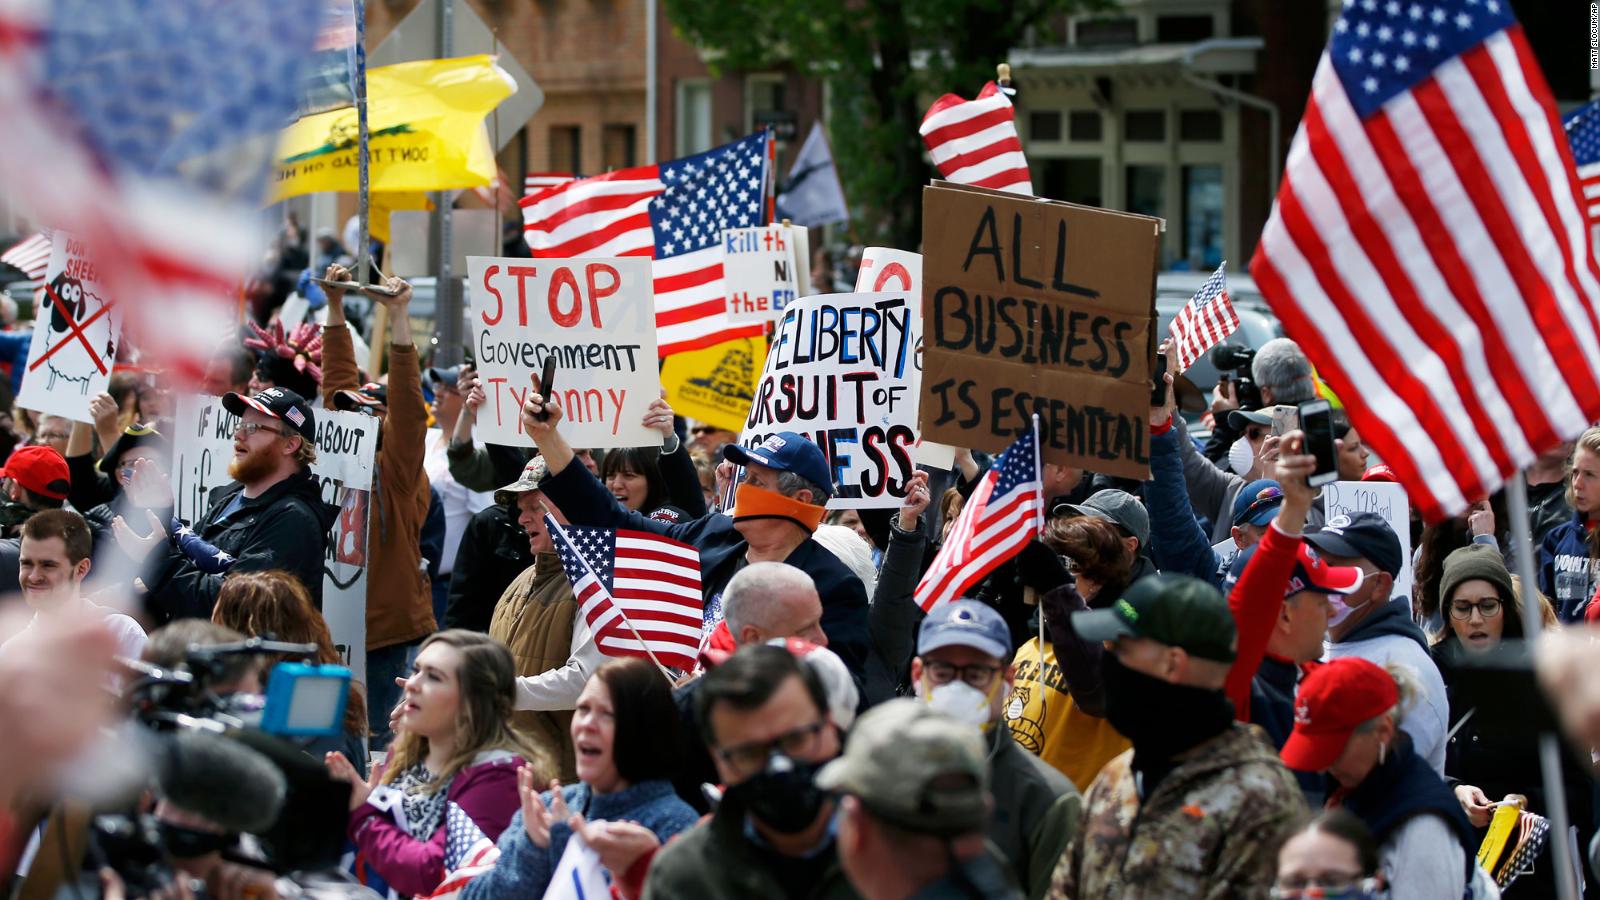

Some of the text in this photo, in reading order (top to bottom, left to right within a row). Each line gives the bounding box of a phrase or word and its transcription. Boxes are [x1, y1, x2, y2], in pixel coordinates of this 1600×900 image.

[763, 230, 786, 252] th
[961, 205, 1100, 299] ALL
[481, 262, 621, 328] STOP
[730, 290, 768, 314] the
[766, 298, 911, 380] FE LIBERTY
[933, 285, 1132, 379] BUSINESS
[198, 405, 212, 438] IF
[315, 420, 365, 455] ABOUT
[487, 377, 626, 435] Tynny
[747, 371, 879, 429] URSUIT
[930, 378, 1150, 465] IS ESSENTIAL
[178, 448, 213, 527] Lif
